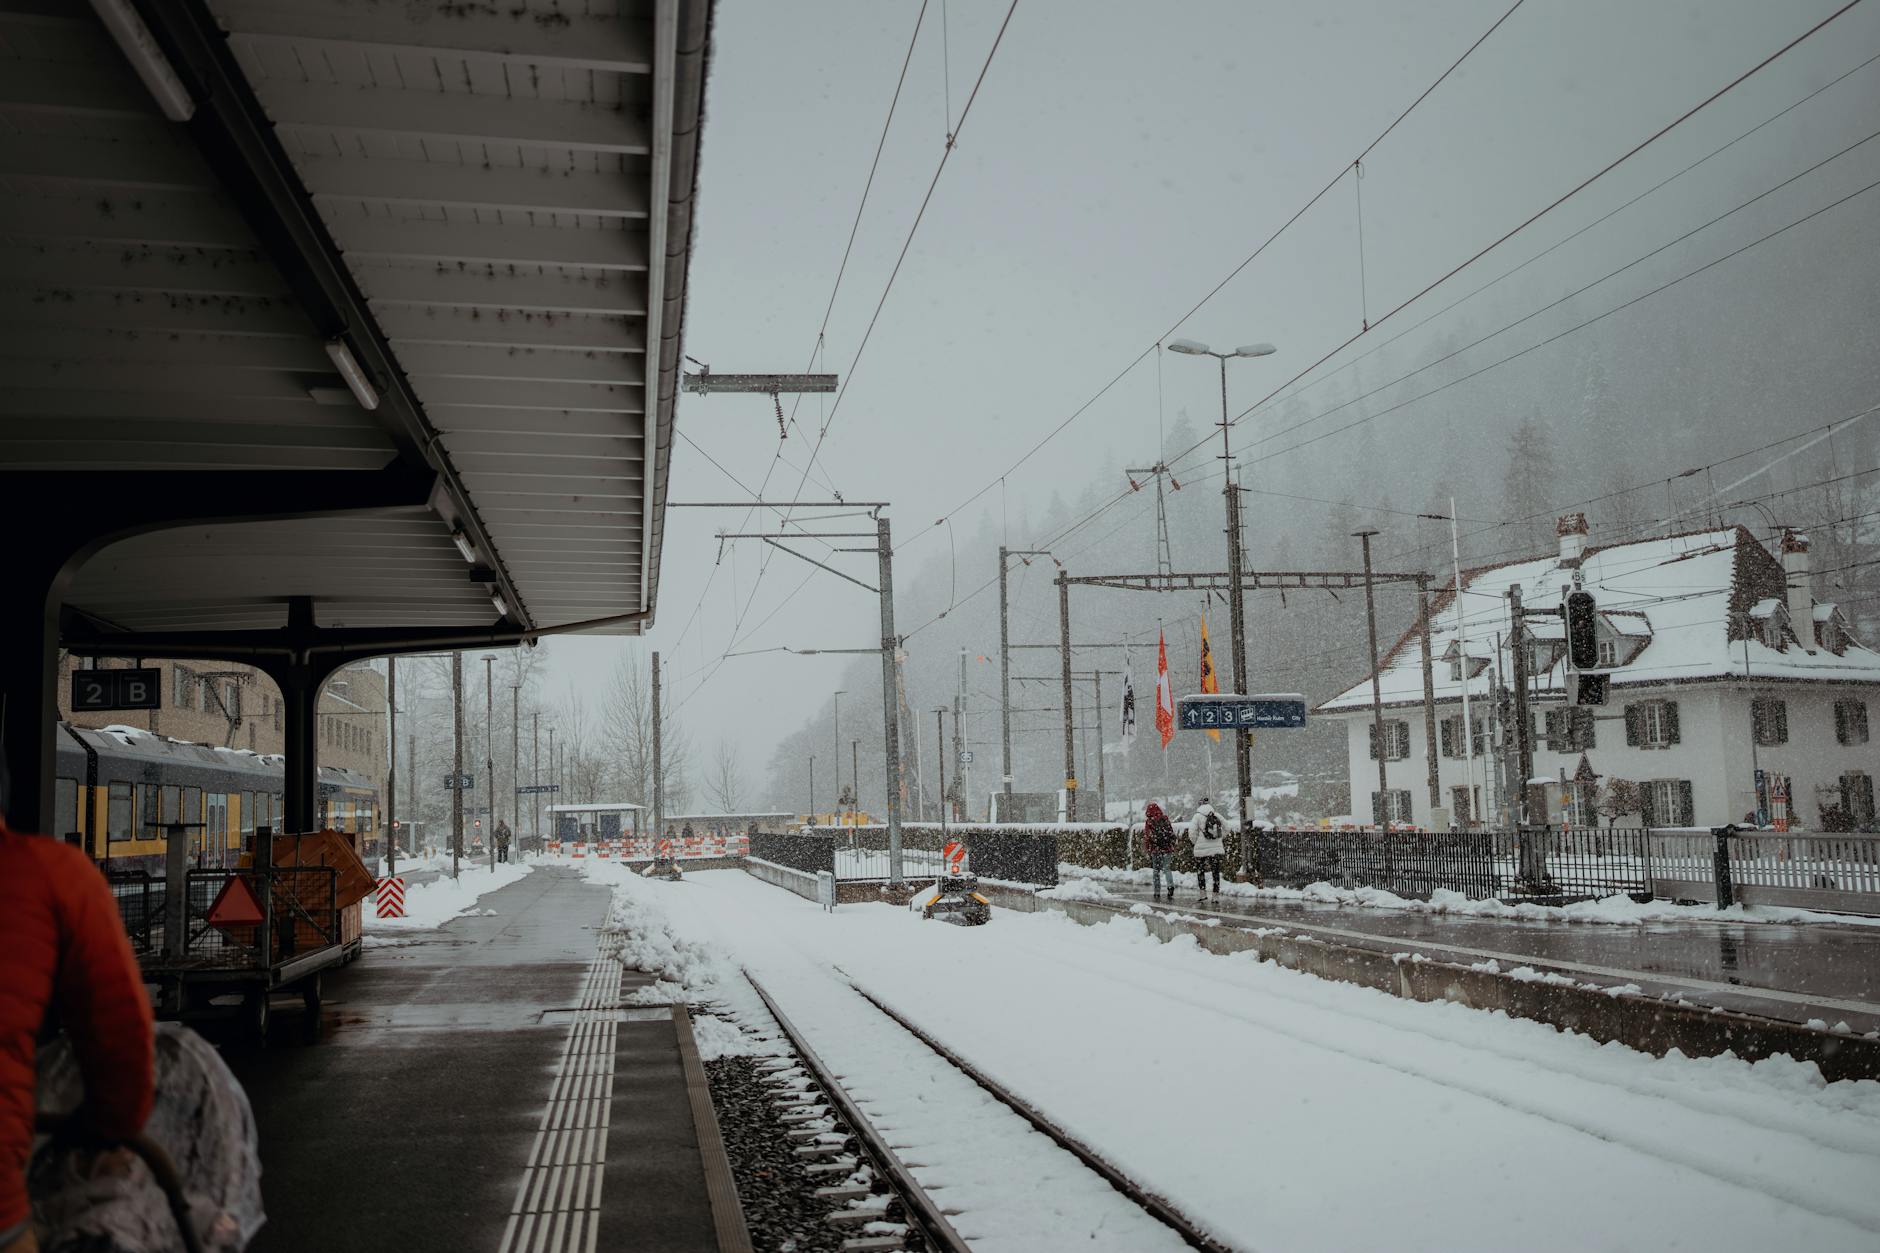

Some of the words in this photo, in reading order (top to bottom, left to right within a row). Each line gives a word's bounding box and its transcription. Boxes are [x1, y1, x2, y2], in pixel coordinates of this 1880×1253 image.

[86, 683, 102, 703] 2
[129, 682, 147, 702] B
[1206, 711, 1214, 722] 2
[1224, 711, 1233, 722] 3
[462, 778, 469, 787] B
